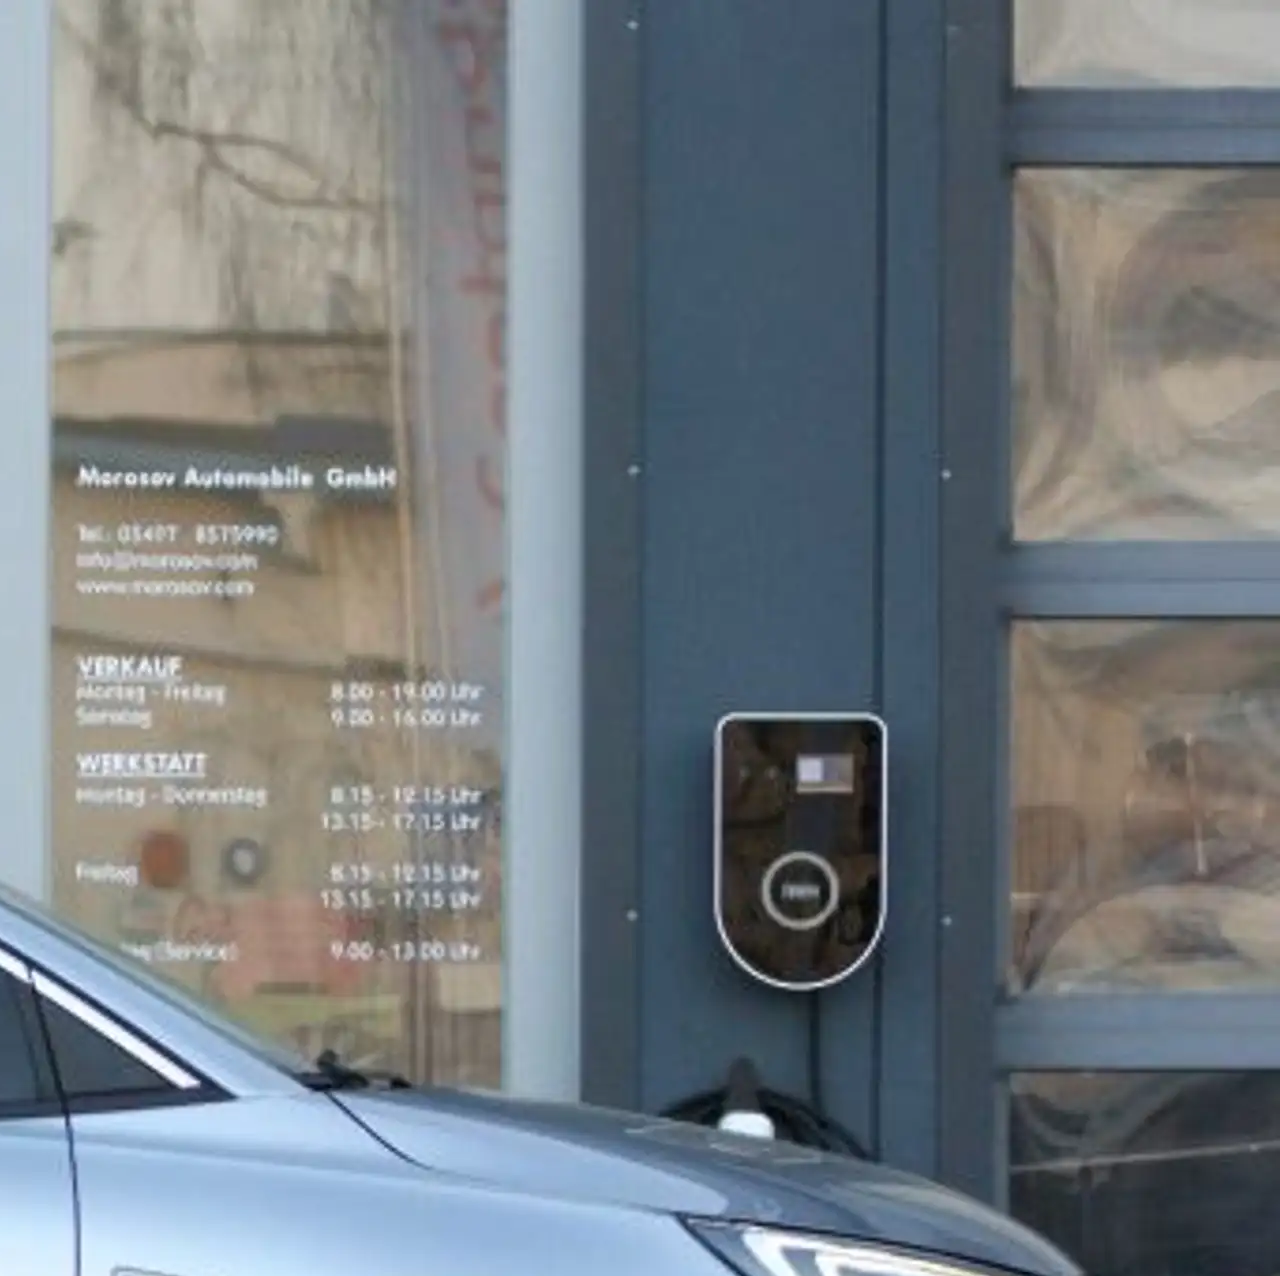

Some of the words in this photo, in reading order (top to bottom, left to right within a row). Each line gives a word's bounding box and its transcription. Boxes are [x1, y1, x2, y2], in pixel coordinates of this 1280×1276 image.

[77, 466, 176, 488] Morosov
[184, 466, 314, 488] Automobile
[326, 466, 397, 488] GmbH
[78, 655, 184, 679] VERKAUF
[451, 682, 483, 701] Uhr
[451, 708, 483, 727] Uhr
[76, 753, 208, 774] WERKSTATT
[451, 787, 482, 805] Uhr
[451, 813, 482, 831] Uhr
[450, 863, 482, 882] Uhr
[450, 890, 482, 909] Uhr
[450, 942, 482, 961] Uhr
